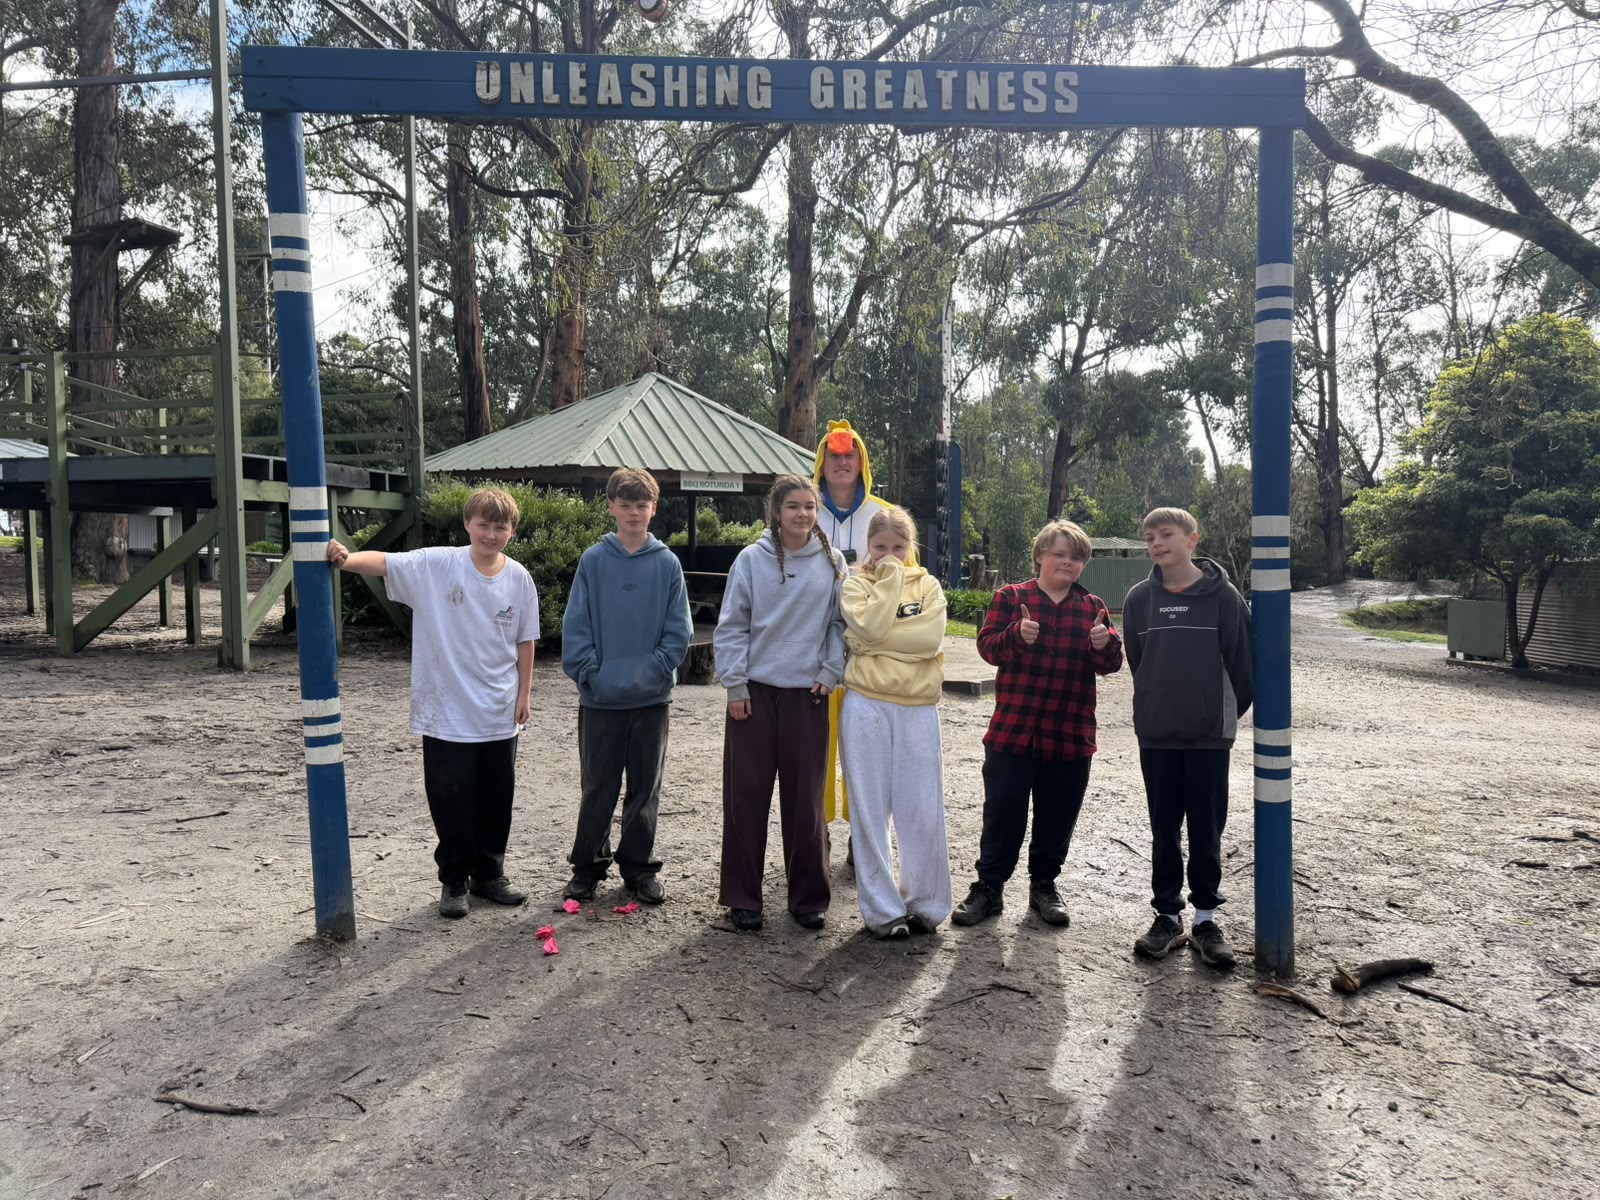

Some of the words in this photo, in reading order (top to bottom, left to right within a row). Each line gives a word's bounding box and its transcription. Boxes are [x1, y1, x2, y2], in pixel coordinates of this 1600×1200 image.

[475, 60, 773, 110] UNLEASHING
[809, 66, 1079, 114] GREATNESS
[683, 480, 699, 488] BBQ
[700, 481, 735, 489] ROTUNDA
